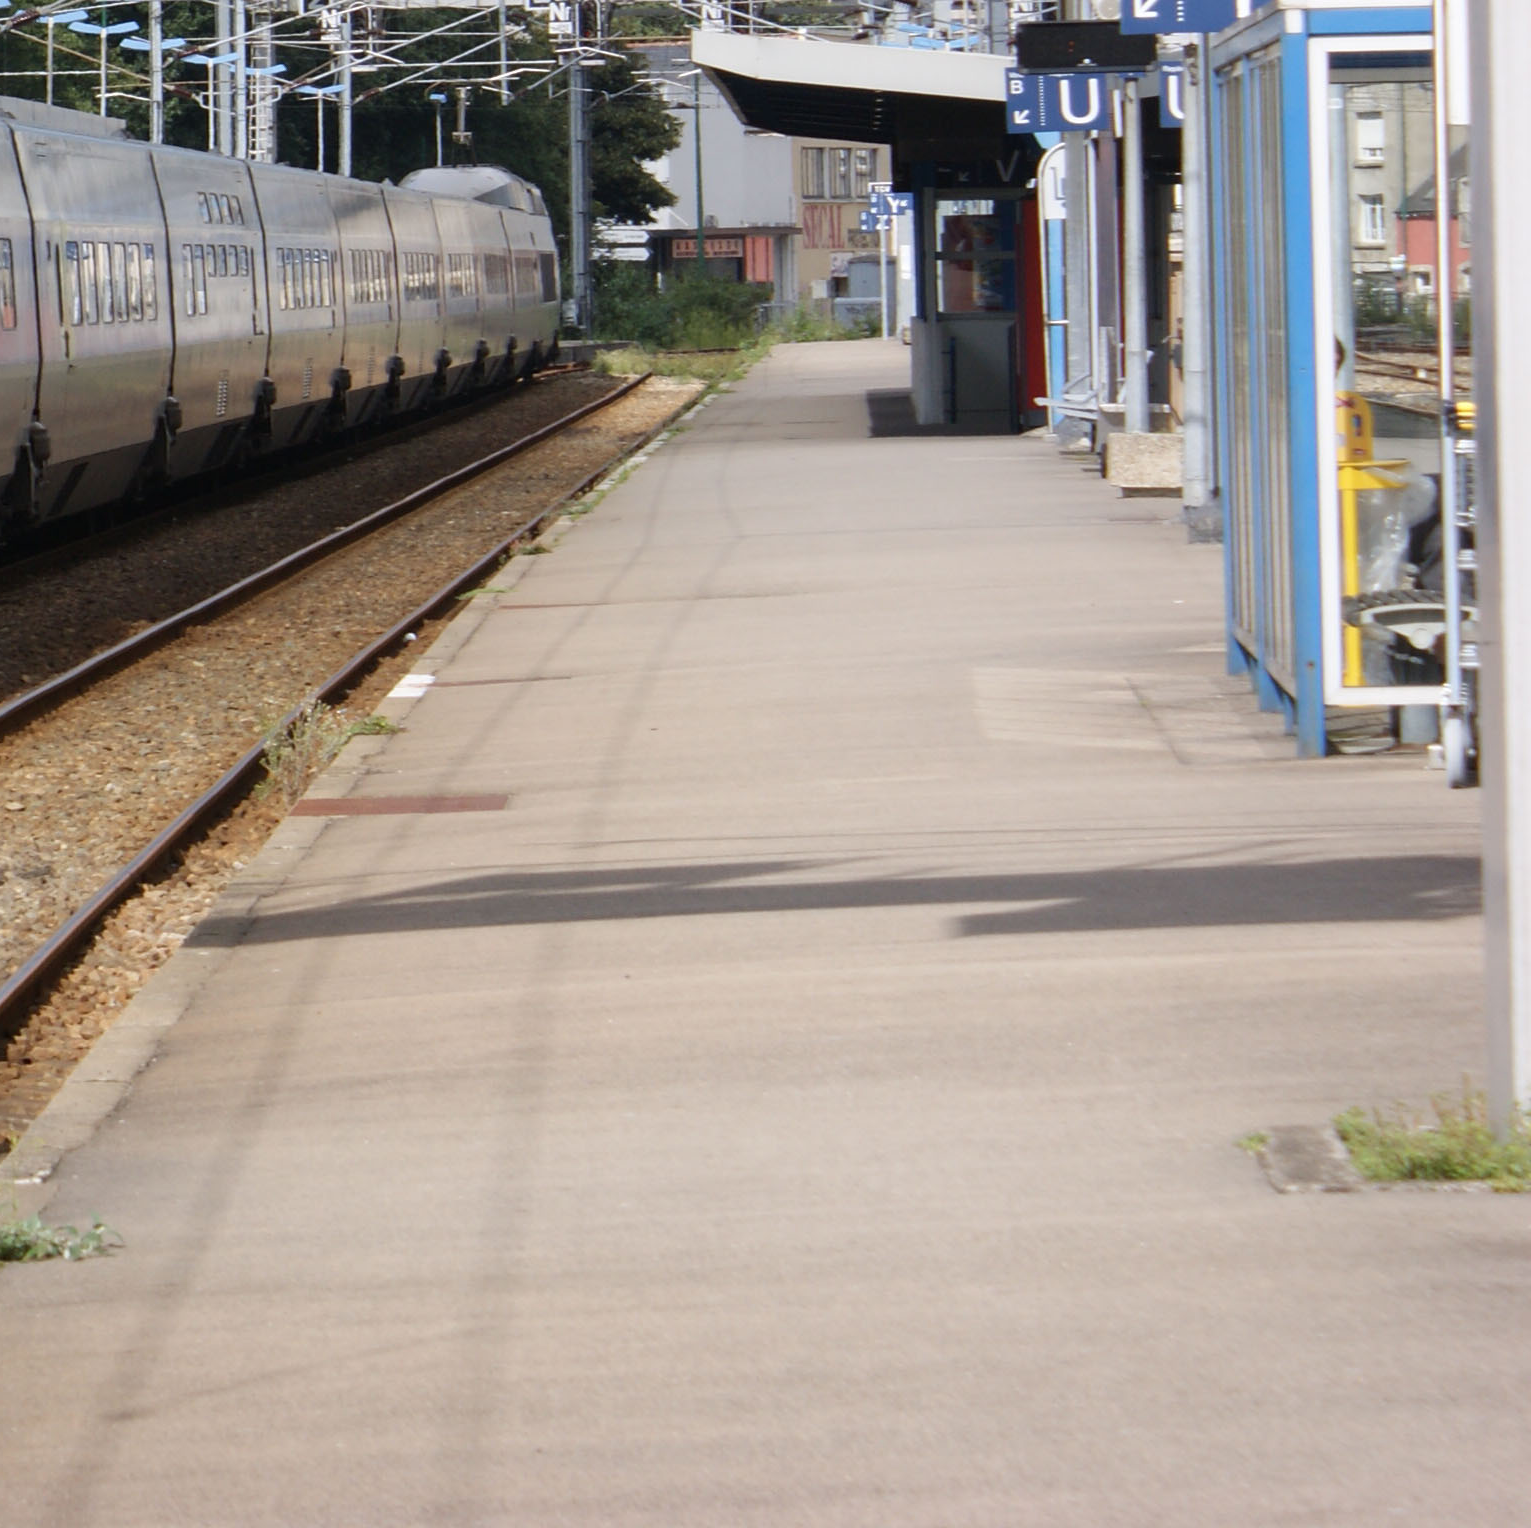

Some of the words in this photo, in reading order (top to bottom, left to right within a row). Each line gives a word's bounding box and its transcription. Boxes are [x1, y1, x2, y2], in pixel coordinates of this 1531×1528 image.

[1009, 79, 1025, 95] B
[1059, 78, 1100, 125] U
[886, 196, 900, 214] Y
